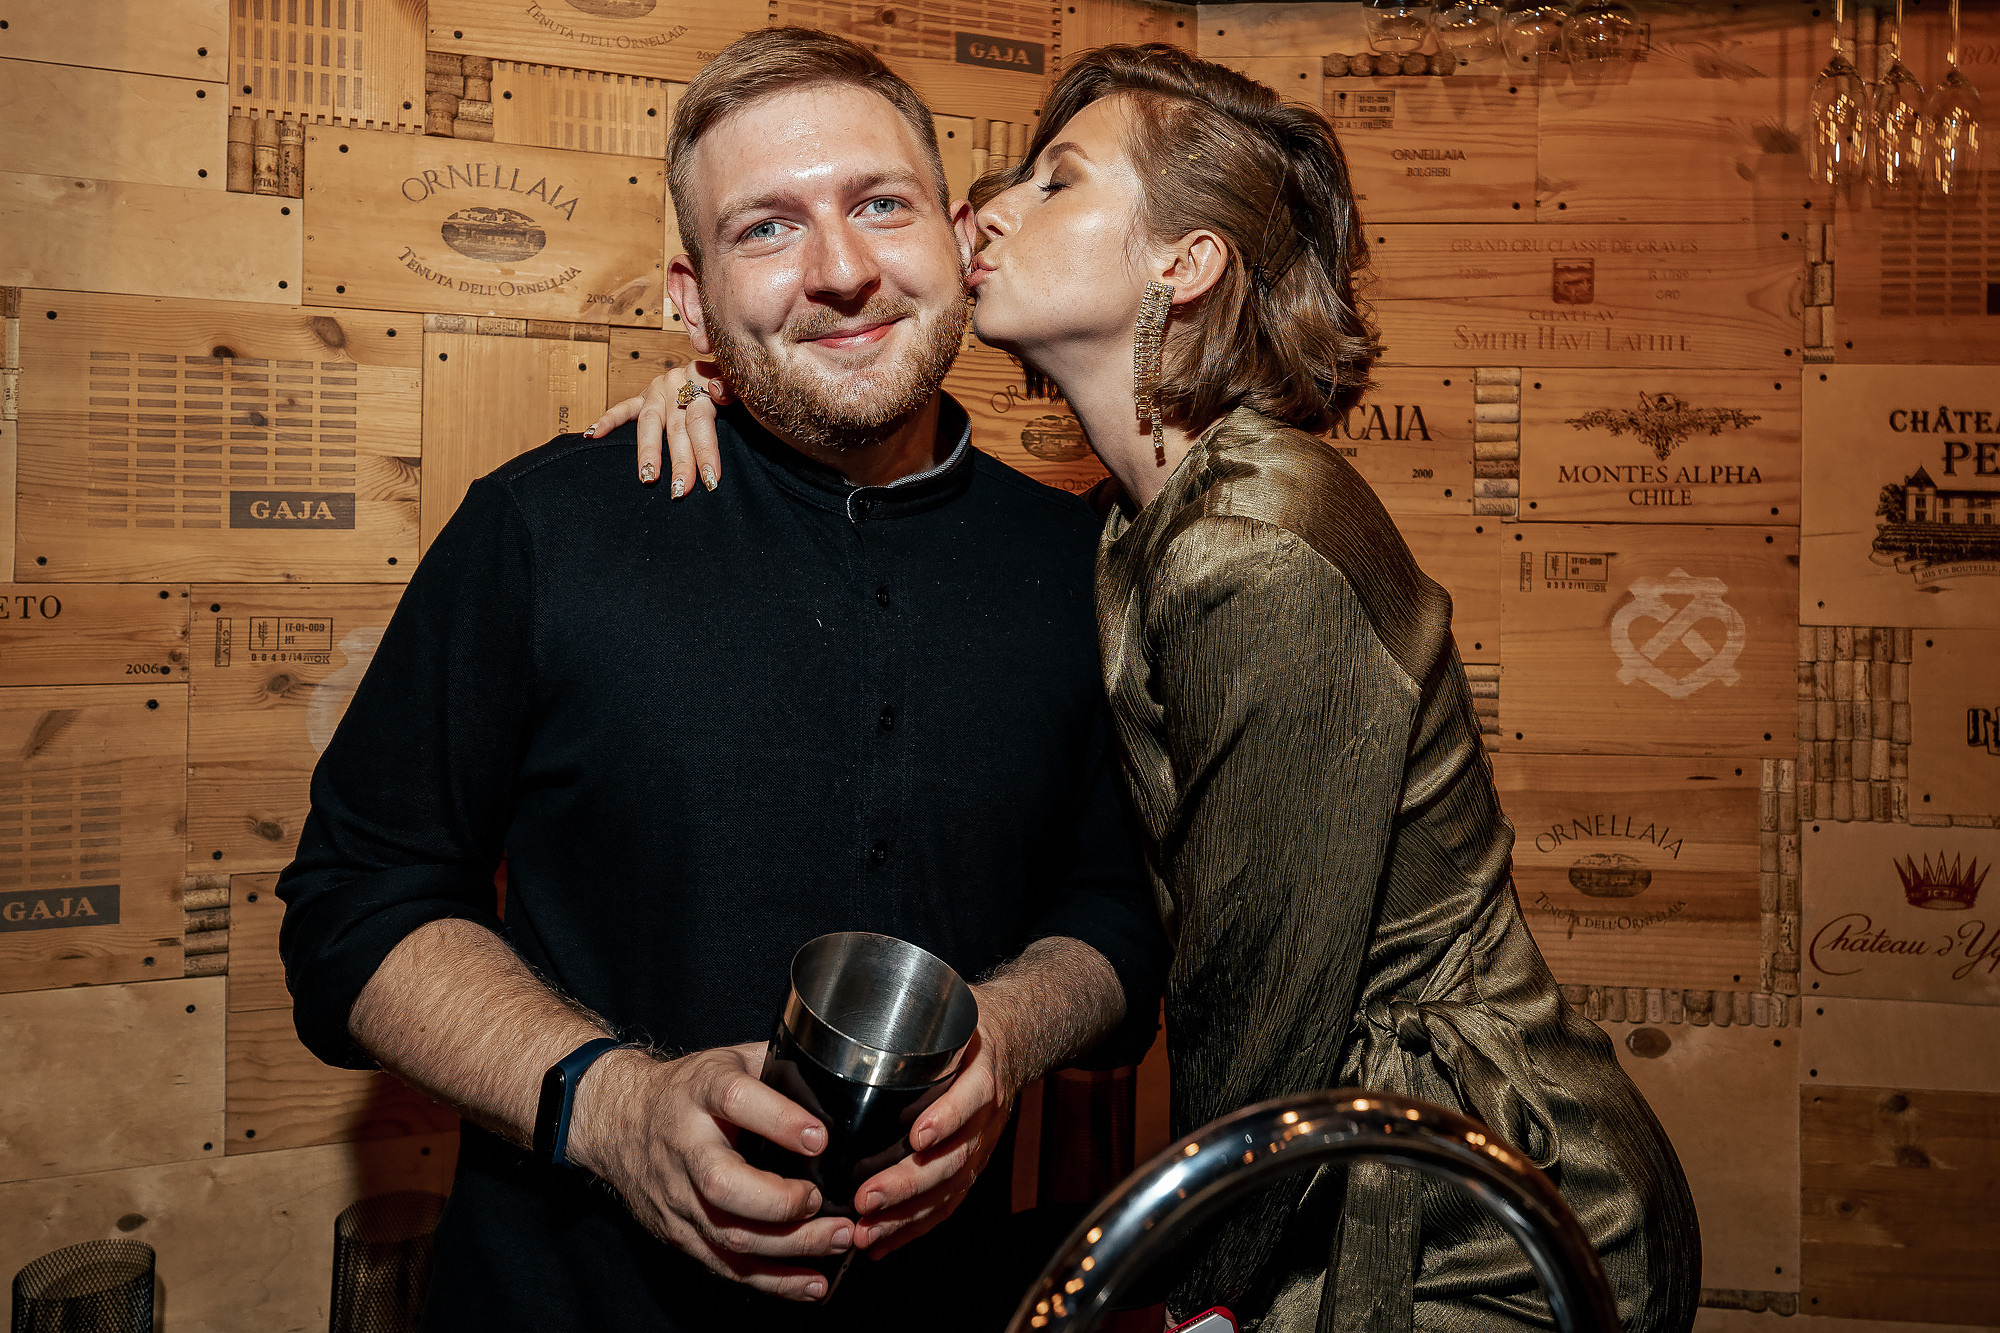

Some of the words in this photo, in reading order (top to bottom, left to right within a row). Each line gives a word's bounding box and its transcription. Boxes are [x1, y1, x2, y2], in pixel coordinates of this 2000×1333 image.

[525, 0, 575, 39] TENUTA
[580, 24, 689, 49] DELL'ORNELLAIA
[969, 42, 1032, 66] GAJA
[1392, 149, 1466, 162] ORNELLAIA
[1406, 167, 1451, 177] BOLGHERI
[401, 163, 580, 221] ORNELLAIA
[1451, 239, 1507, 253] GRAND
[1611, 239, 1633, 253] DE
[1636, 239, 1699, 253] GRAVES
[398, 246, 454, 289] TENUTA
[458, 266, 582, 297] DELL'ORNELLAIA
[587, 293, 614, 305] 2006
[1889, 405, 2000, 434] CHÂTE
[1412, 468, 1434, 479] 2000
[1558, 465, 1668, 484] MONTES
[1674, 465, 1763, 484] ALPHA
[1628, 489, 1693, 507] CHILE
[250, 501, 336, 521] GAJA
[284, 635, 295, 645] HT
[125, 663, 159, 675] 2006
[1535, 814, 1684, 860] ORNELLAIA
[2, 897, 98, 921] GAJA
[1534, 891, 1581, 926] TENUTA
[1809, 912, 1931, 976] Château
